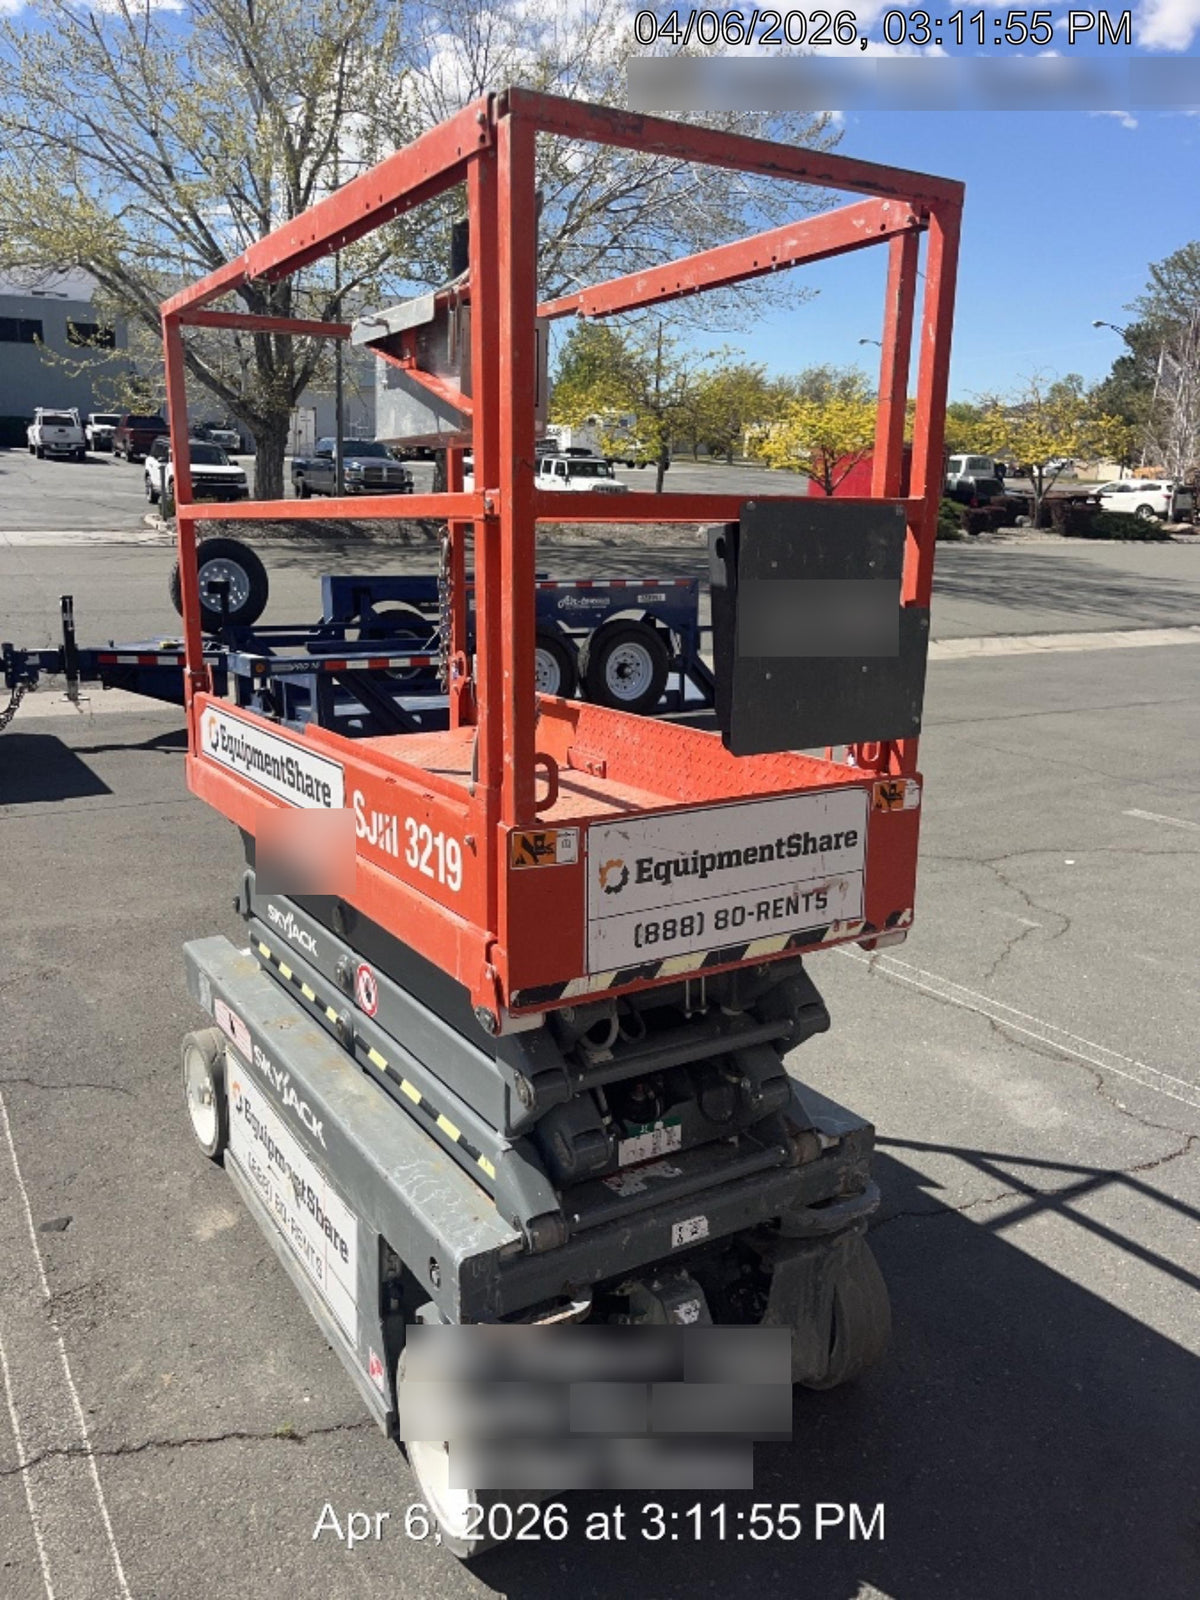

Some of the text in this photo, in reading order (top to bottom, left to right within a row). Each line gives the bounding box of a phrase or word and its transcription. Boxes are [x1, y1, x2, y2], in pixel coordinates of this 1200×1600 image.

[219, 724, 332, 808] EquipmentShare
[404, 816, 462, 892] 3219
[634, 829, 858, 885] EquipmentShare
[633, 892, 828, 948] (888) 80-RENTS
